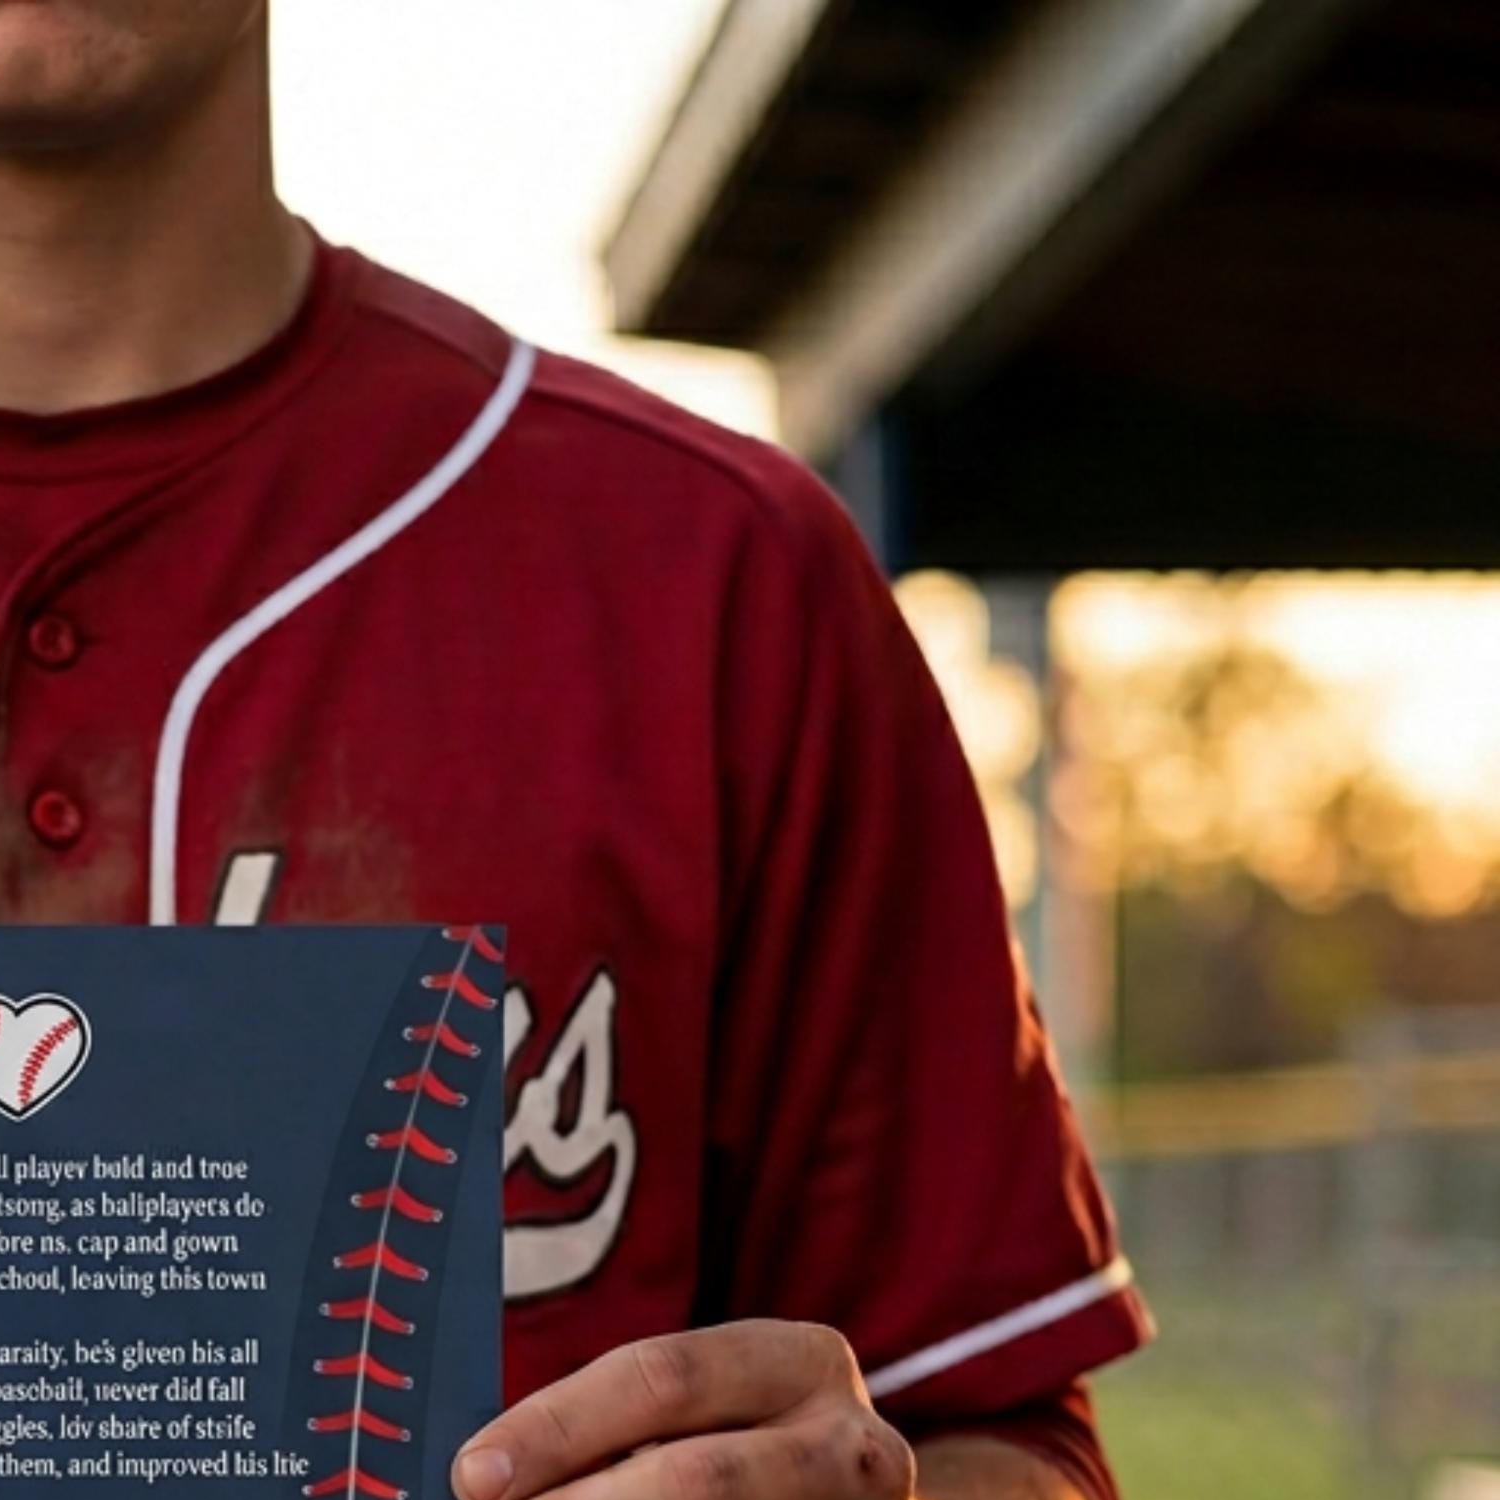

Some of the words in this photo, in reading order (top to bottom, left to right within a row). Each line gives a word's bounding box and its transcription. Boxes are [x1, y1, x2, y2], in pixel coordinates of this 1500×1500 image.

[69, 1197, 97, 1218] as
[76, 1235, 120, 1262] cap
[122, 1227, 168, 1255] and
[172, 1234, 239, 1263] gown
[159, 1265, 204, 1291] this
[206, 1268, 268, 1291] town
[229, 1338, 259, 1365] all
[163, 1376, 204, 1402] did
[207, 1375, 246, 1402] fall
[166, 1413, 193, 1440] of
[66, 1450, 112, 1477] and
